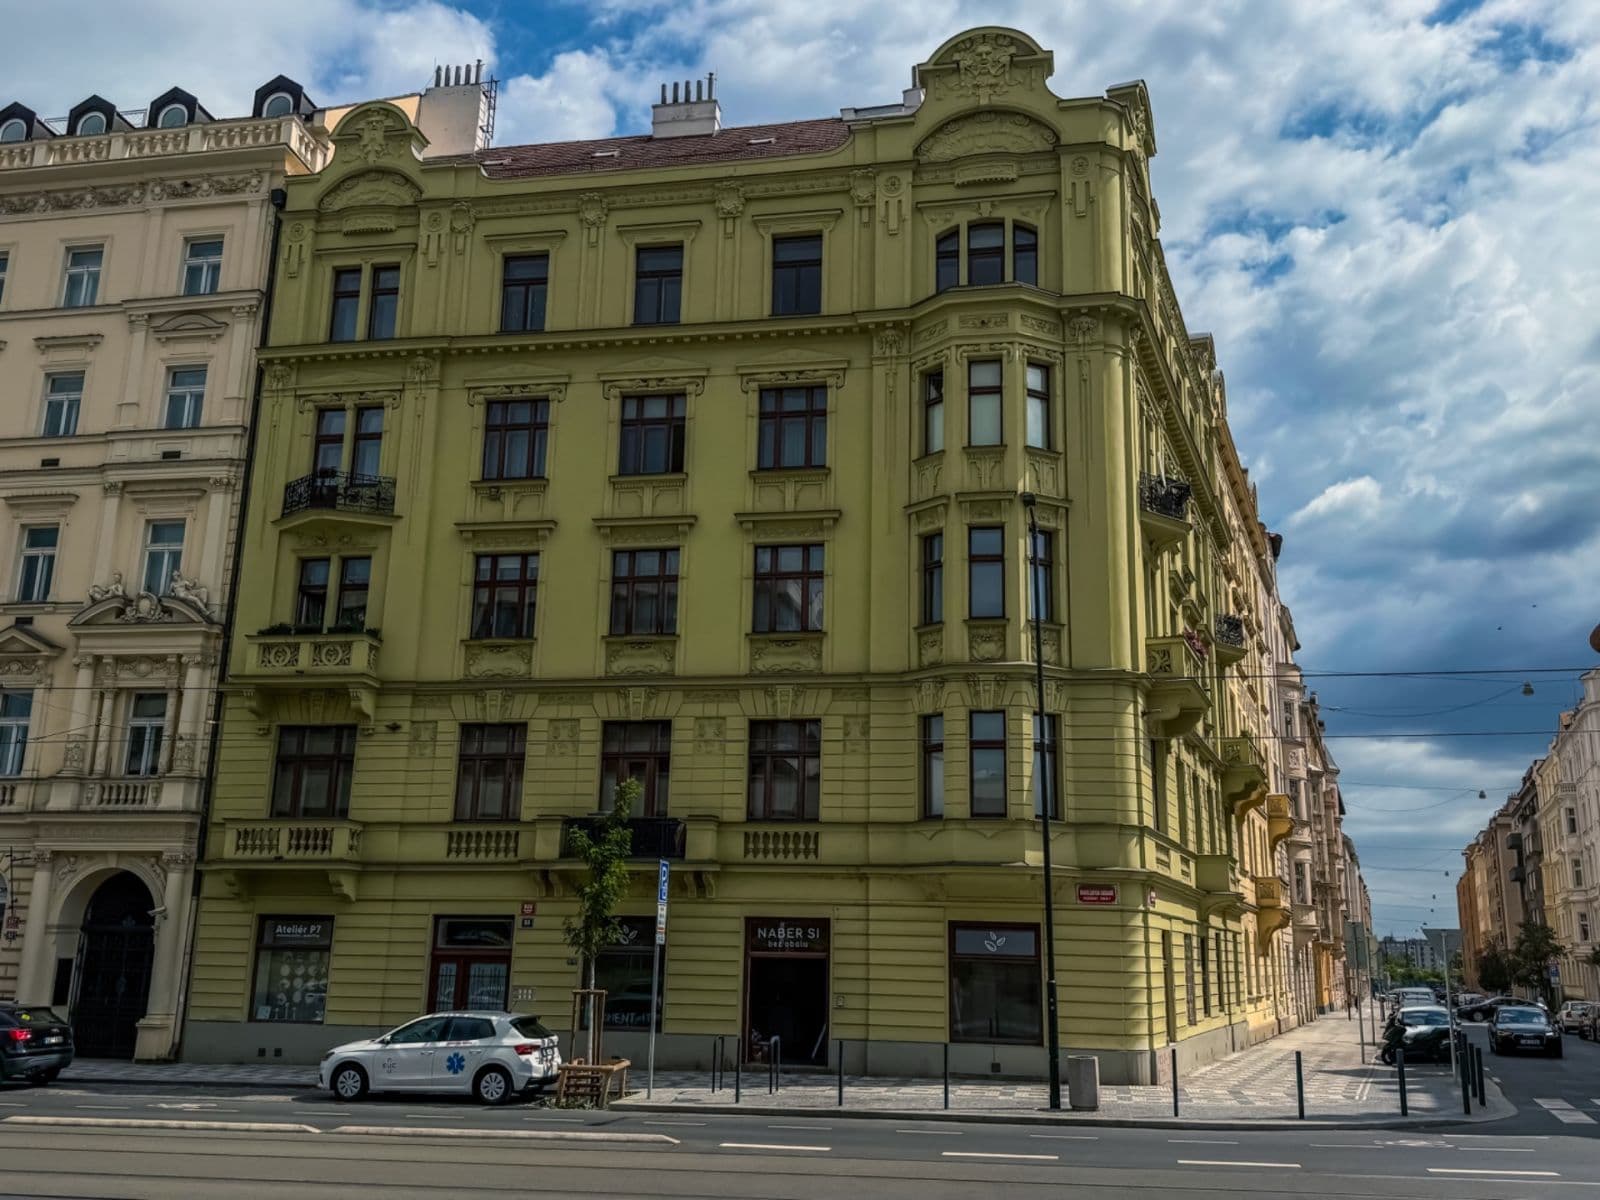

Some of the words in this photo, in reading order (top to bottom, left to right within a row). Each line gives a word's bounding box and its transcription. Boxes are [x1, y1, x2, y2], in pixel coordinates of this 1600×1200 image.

[276, 925, 307, 934] Ateliér
[310, 925, 322, 934] P7
[758, 928, 803, 939] NABER
[807, 928, 820, 939] SI
